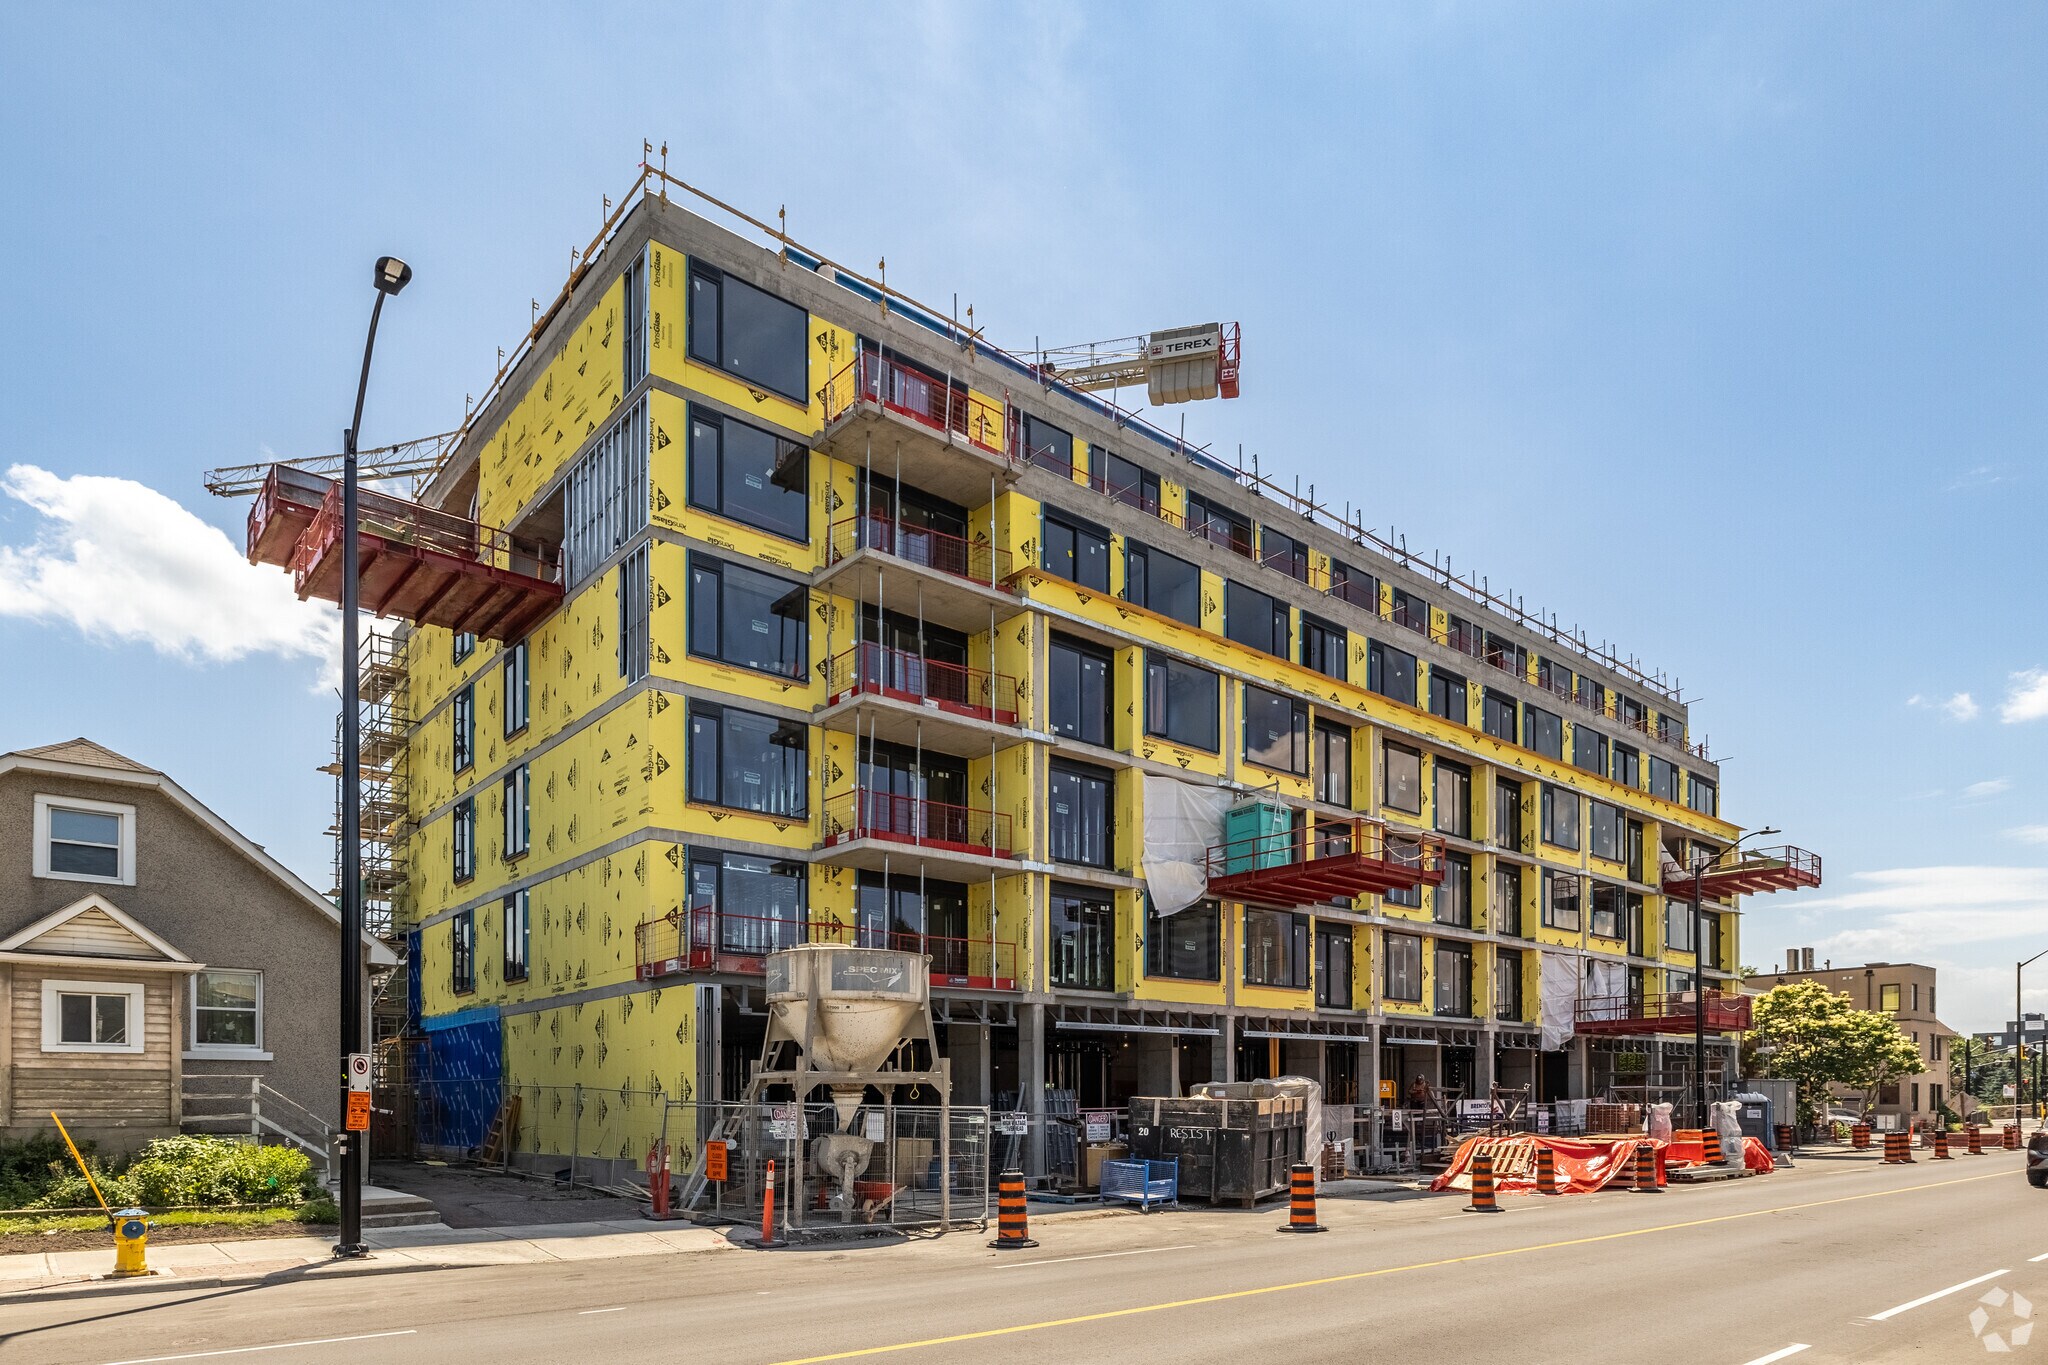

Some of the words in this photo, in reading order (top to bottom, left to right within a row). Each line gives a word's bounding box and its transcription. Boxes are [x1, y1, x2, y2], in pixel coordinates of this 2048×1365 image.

[653, 250, 661, 288] DensGlass
[653, 312, 661, 349] DensGlass
[1166, 337, 1212, 353] TEREX
[758, 552, 792, 569] DensGlass
[848, 966, 878, 974] SPEC
[1138, 1127, 1149, 1136] 20
[1170, 1126, 1212, 1140] RESIST
